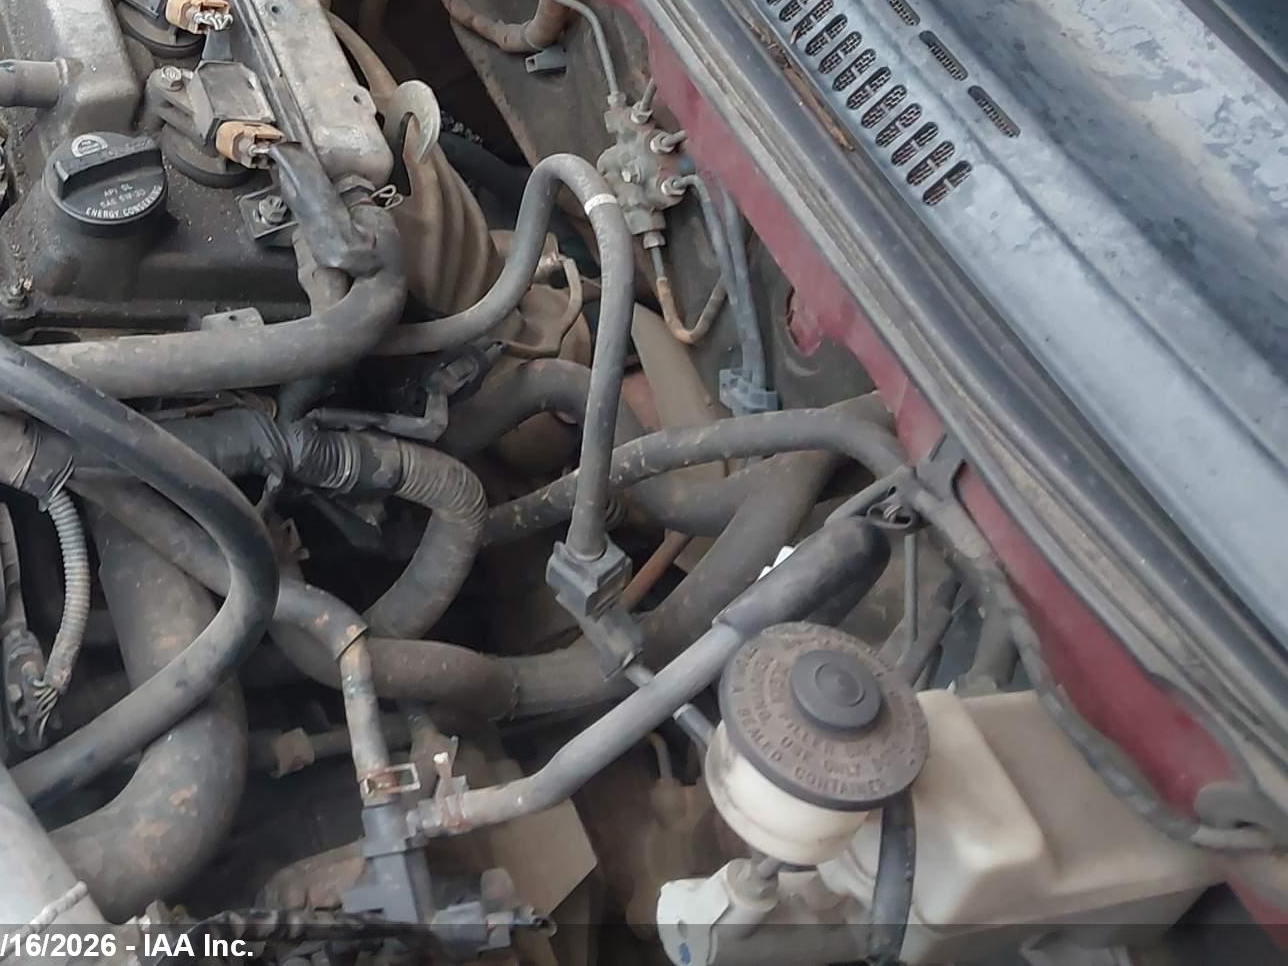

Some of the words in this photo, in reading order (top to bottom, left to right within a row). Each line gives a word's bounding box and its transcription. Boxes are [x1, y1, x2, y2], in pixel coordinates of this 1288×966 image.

[103, 187, 119, 198] API
[99, 195, 118, 209] SAE
[85, 207, 120, 219] ENERGY
[794, 765, 889, 796] CONTAINER
